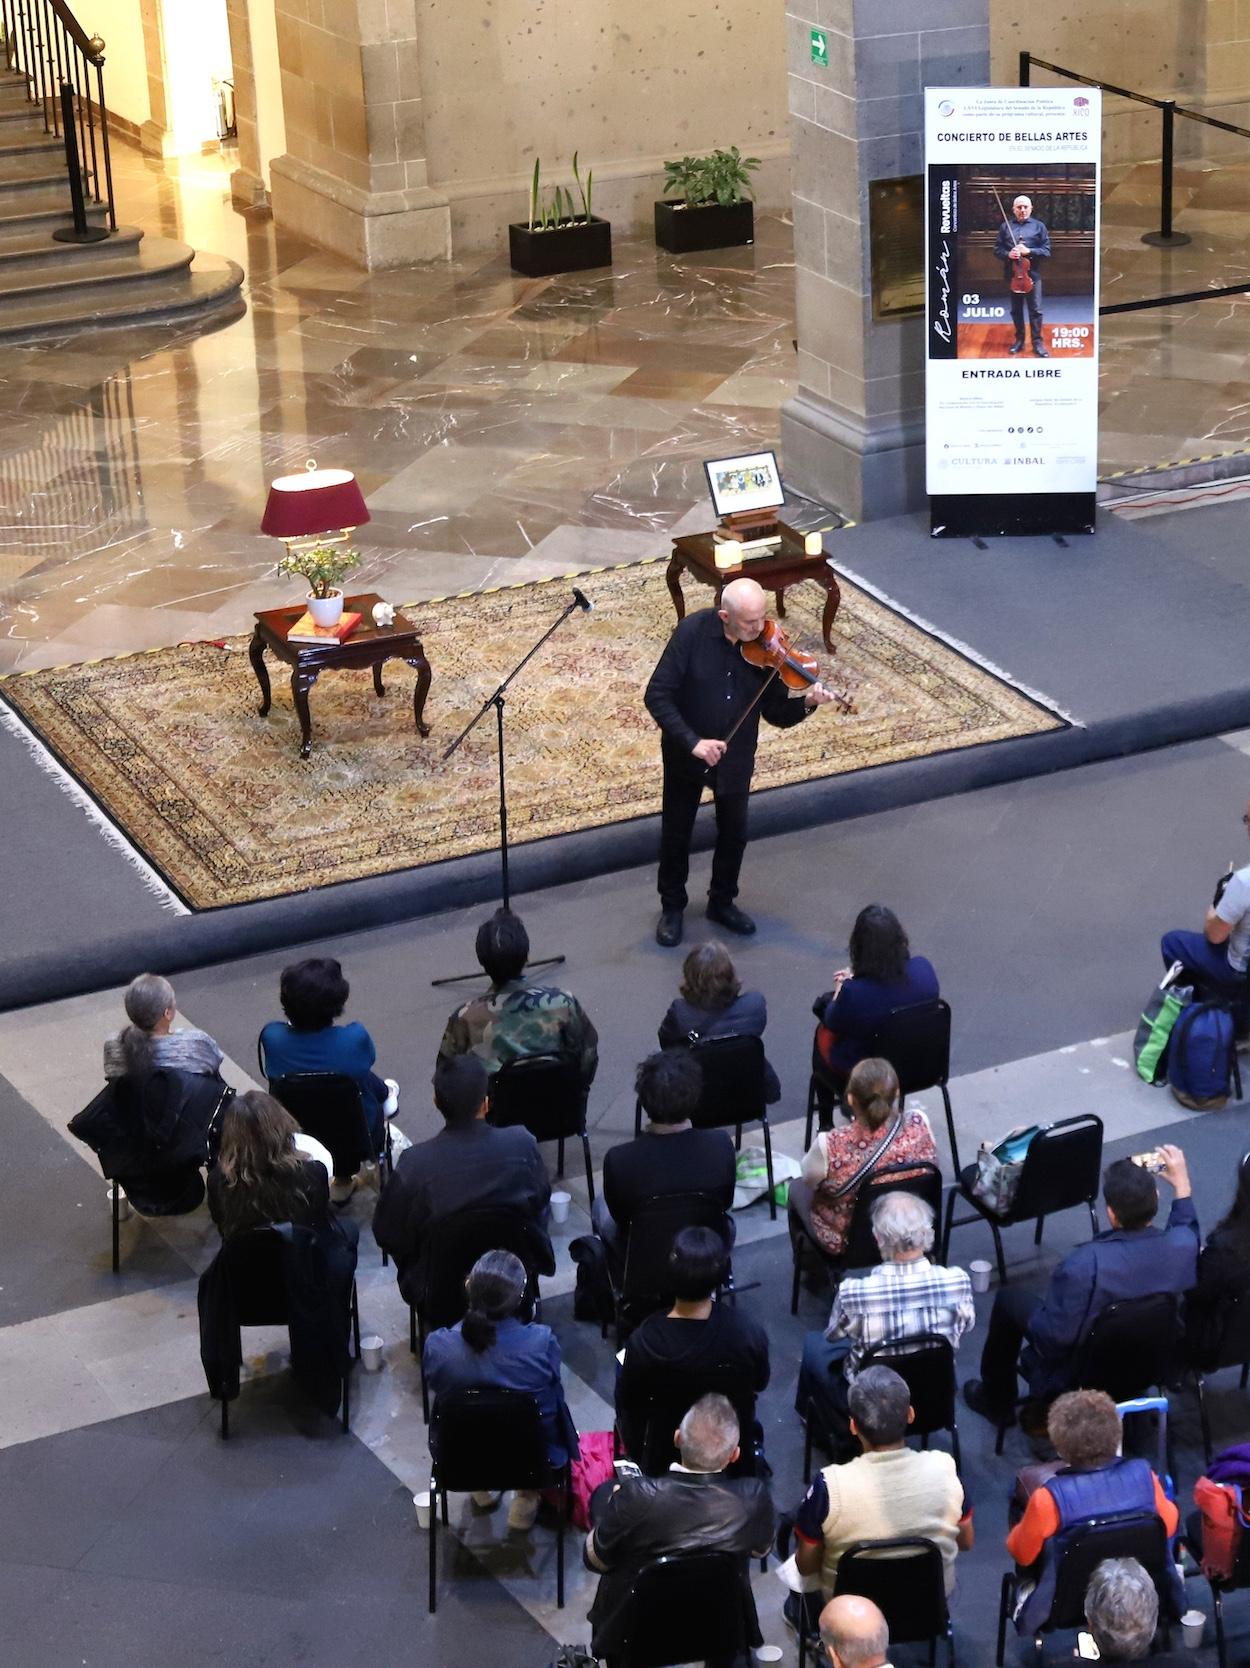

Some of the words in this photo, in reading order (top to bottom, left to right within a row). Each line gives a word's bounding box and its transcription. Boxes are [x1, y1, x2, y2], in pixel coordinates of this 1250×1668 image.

[937, 132, 995, 142] CONCIERTO
[998, 132, 1011, 142] DE
[1014, 132, 1052, 142] BELLAS
[1055, 131, 1088, 141] ARTES
[939, 180, 951, 234] Revueltas
[934, 240, 952, 343] Román
[962, 294, 980, 305] 03
[962, 307, 1005, 317] JULIO
[1052, 327, 1089, 338] 19:00
[1052, 338, 1084, 348] HRS.
[962, 370, 1020, 379] ENTRADA
[1025, 369, 1061, 378] LIBRE
[952, 457, 998, 465] CULTURA
[1013, 457, 1046, 465] INBAL
